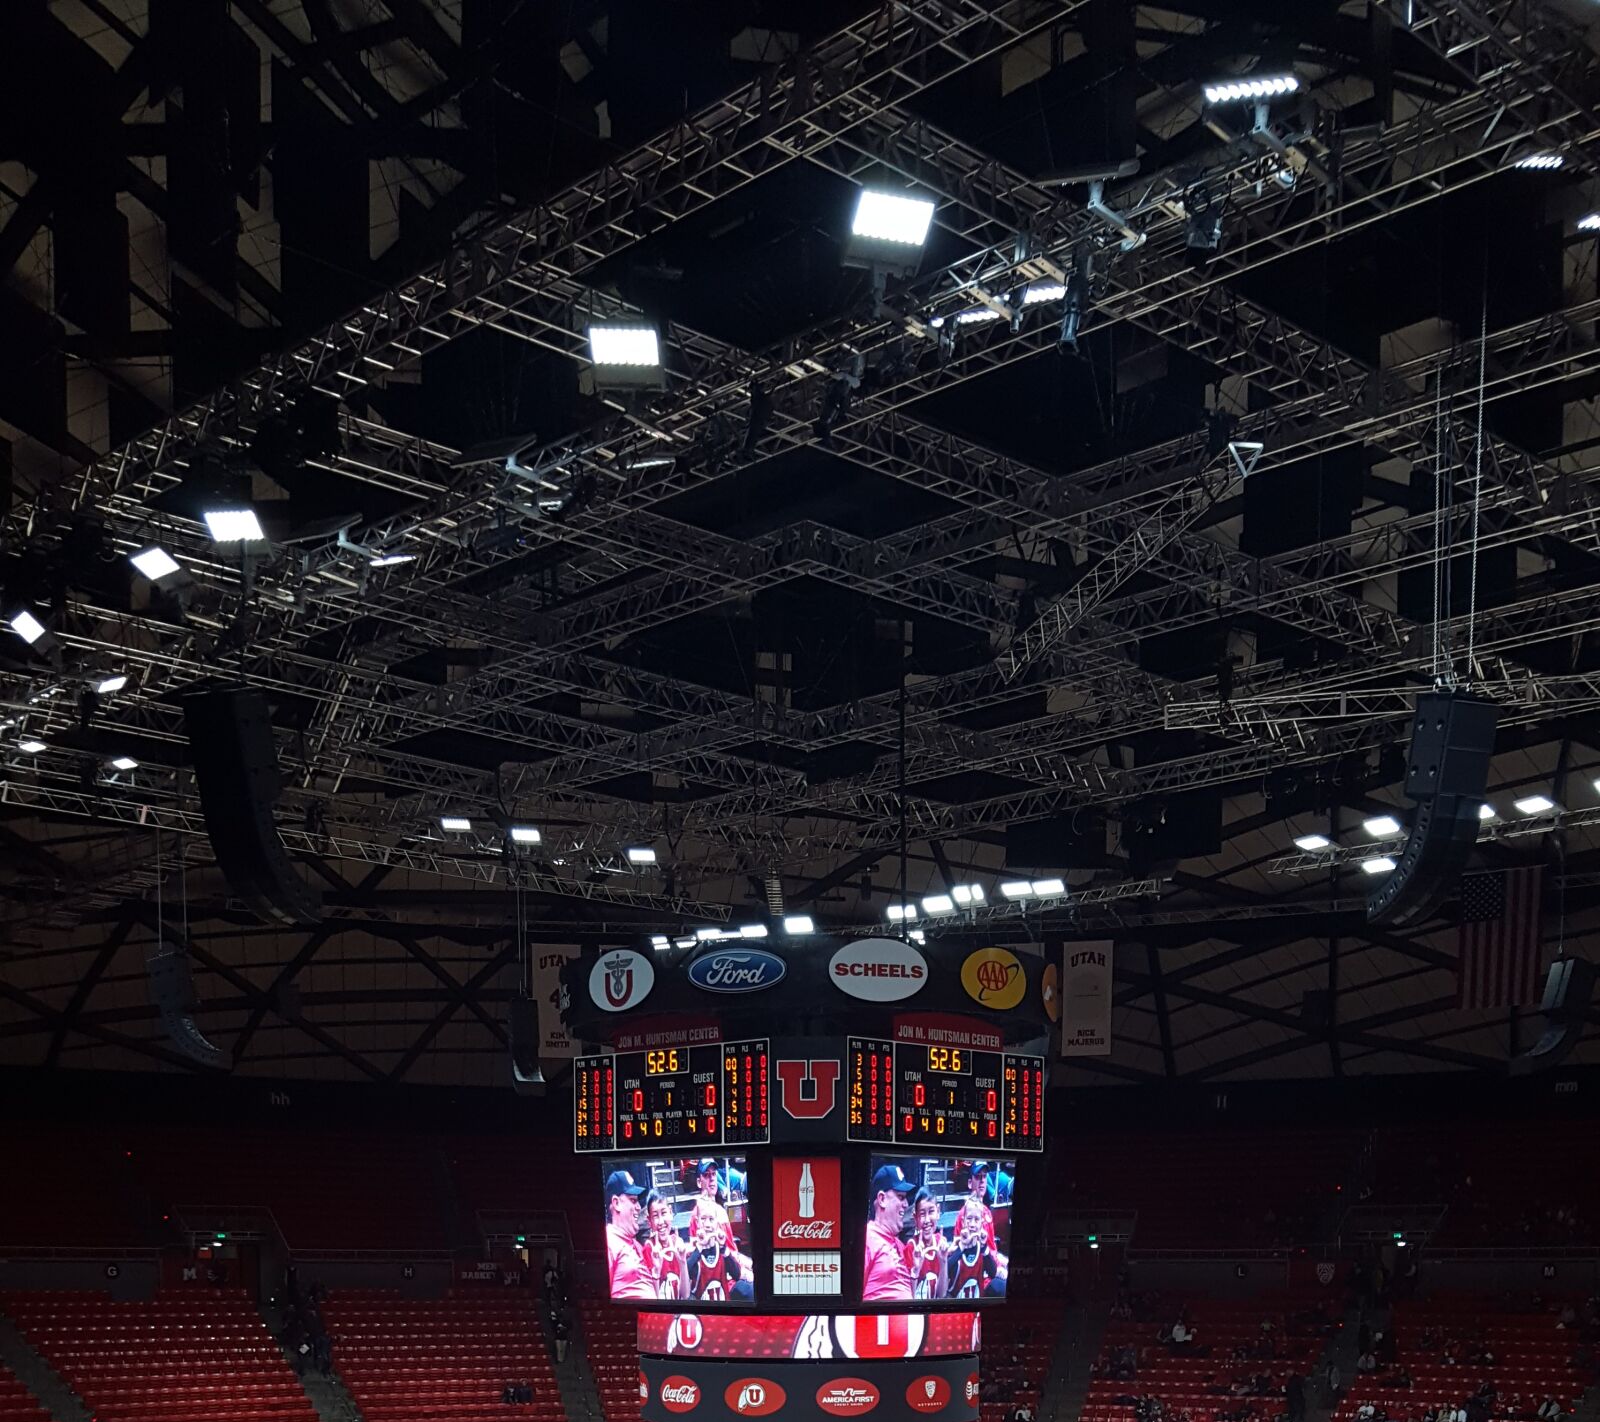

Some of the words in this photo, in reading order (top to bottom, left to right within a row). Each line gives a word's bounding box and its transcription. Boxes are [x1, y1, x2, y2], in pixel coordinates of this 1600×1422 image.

[540, 954, 568, 969] UTA
[1070, 951, 1106, 967] UTAH
[706, 956, 767, 984] Ford
[834, 963, 924, 979] SCHEELS
[981, 964, 1008, 986] AAA
[618, 1038, 632, 1048] JON
[634, 1036, 644, 1045] M.
[645, 1032, 687, 1045] HUNTSMAN
[689, 1027, 718, 1040] CENTER
[898, 1027, 914, 1038] JON
[915, 1029, 926, 1039] M.
[928, 1028, 969, 1044] HUNTSMAN
[972, 1033, 1000, 1048] CENTER
[648, 1050, 678, 1073] 52.6
[726, 1058, 737, 1071] 00
[857, 1054, 862, 1066] 3
[930, 1048, 961, 1071] 52.6
[582, 1072, 587, 1082] 3
[693, 1073, 714, 1083] GUEST
[732, 1072, 737, 1084] 3
[857, 1068, 862, 1080] 5
[905, 1071, 921, 1082] UTAH
[1005, 1069, 1016, 1080] 00
[624, 1079, 640, 1089] UTAH
[854, 1083, 862, 1094] 15
[975, 1078, 995, 1088] GUEST
[1011, 1083, 1016, 1093] 3
[582, 1085, 587, 1096] 5
[732, 1088, 737, 1097] 4
[776, 1060, 841, 1119] U
[578, 1098, 587, 1109] 15
[633, 1090, 643, 1111] 0
[706, 1085, 715, 1106] 0
[851, 1097, 862, 1108] 34
[914, 1085, 924, 1106] 0
[986, 1091, 996, 1111] 0
[1011, 1097, 1016, 1106] 4
[732, 1100, 737, 1112] 5
[578, 1111, 587, 1123] 34
[851, 1111, 862, 1124] 35
[1011, 1109, 1016, 1121] 5
[624, 1121, 632, 1138] 0
[640, 1122, 647, 1136] 4
[655, 1120, 662, 1136] 0
[688, 1119, 696, 1133] 4
[707, 1116, 715, 1133] 0
[726, 1116, 737, 1127] 24
[905, 1115, 913, 1132] 0
[921, 1118, 929, 1131] 4
[937, 1117, 944, 1134] 0
[970, 1121, 978, 1134] 4
[988, 1121, 996, 1137] 0
[578, 1125, 587, 1136] 35
[1005, 1122, 1016, 1134] 24
[774, 1263, 839, 1273] SCHEELS
[680, 1318, 696, 1345] U
